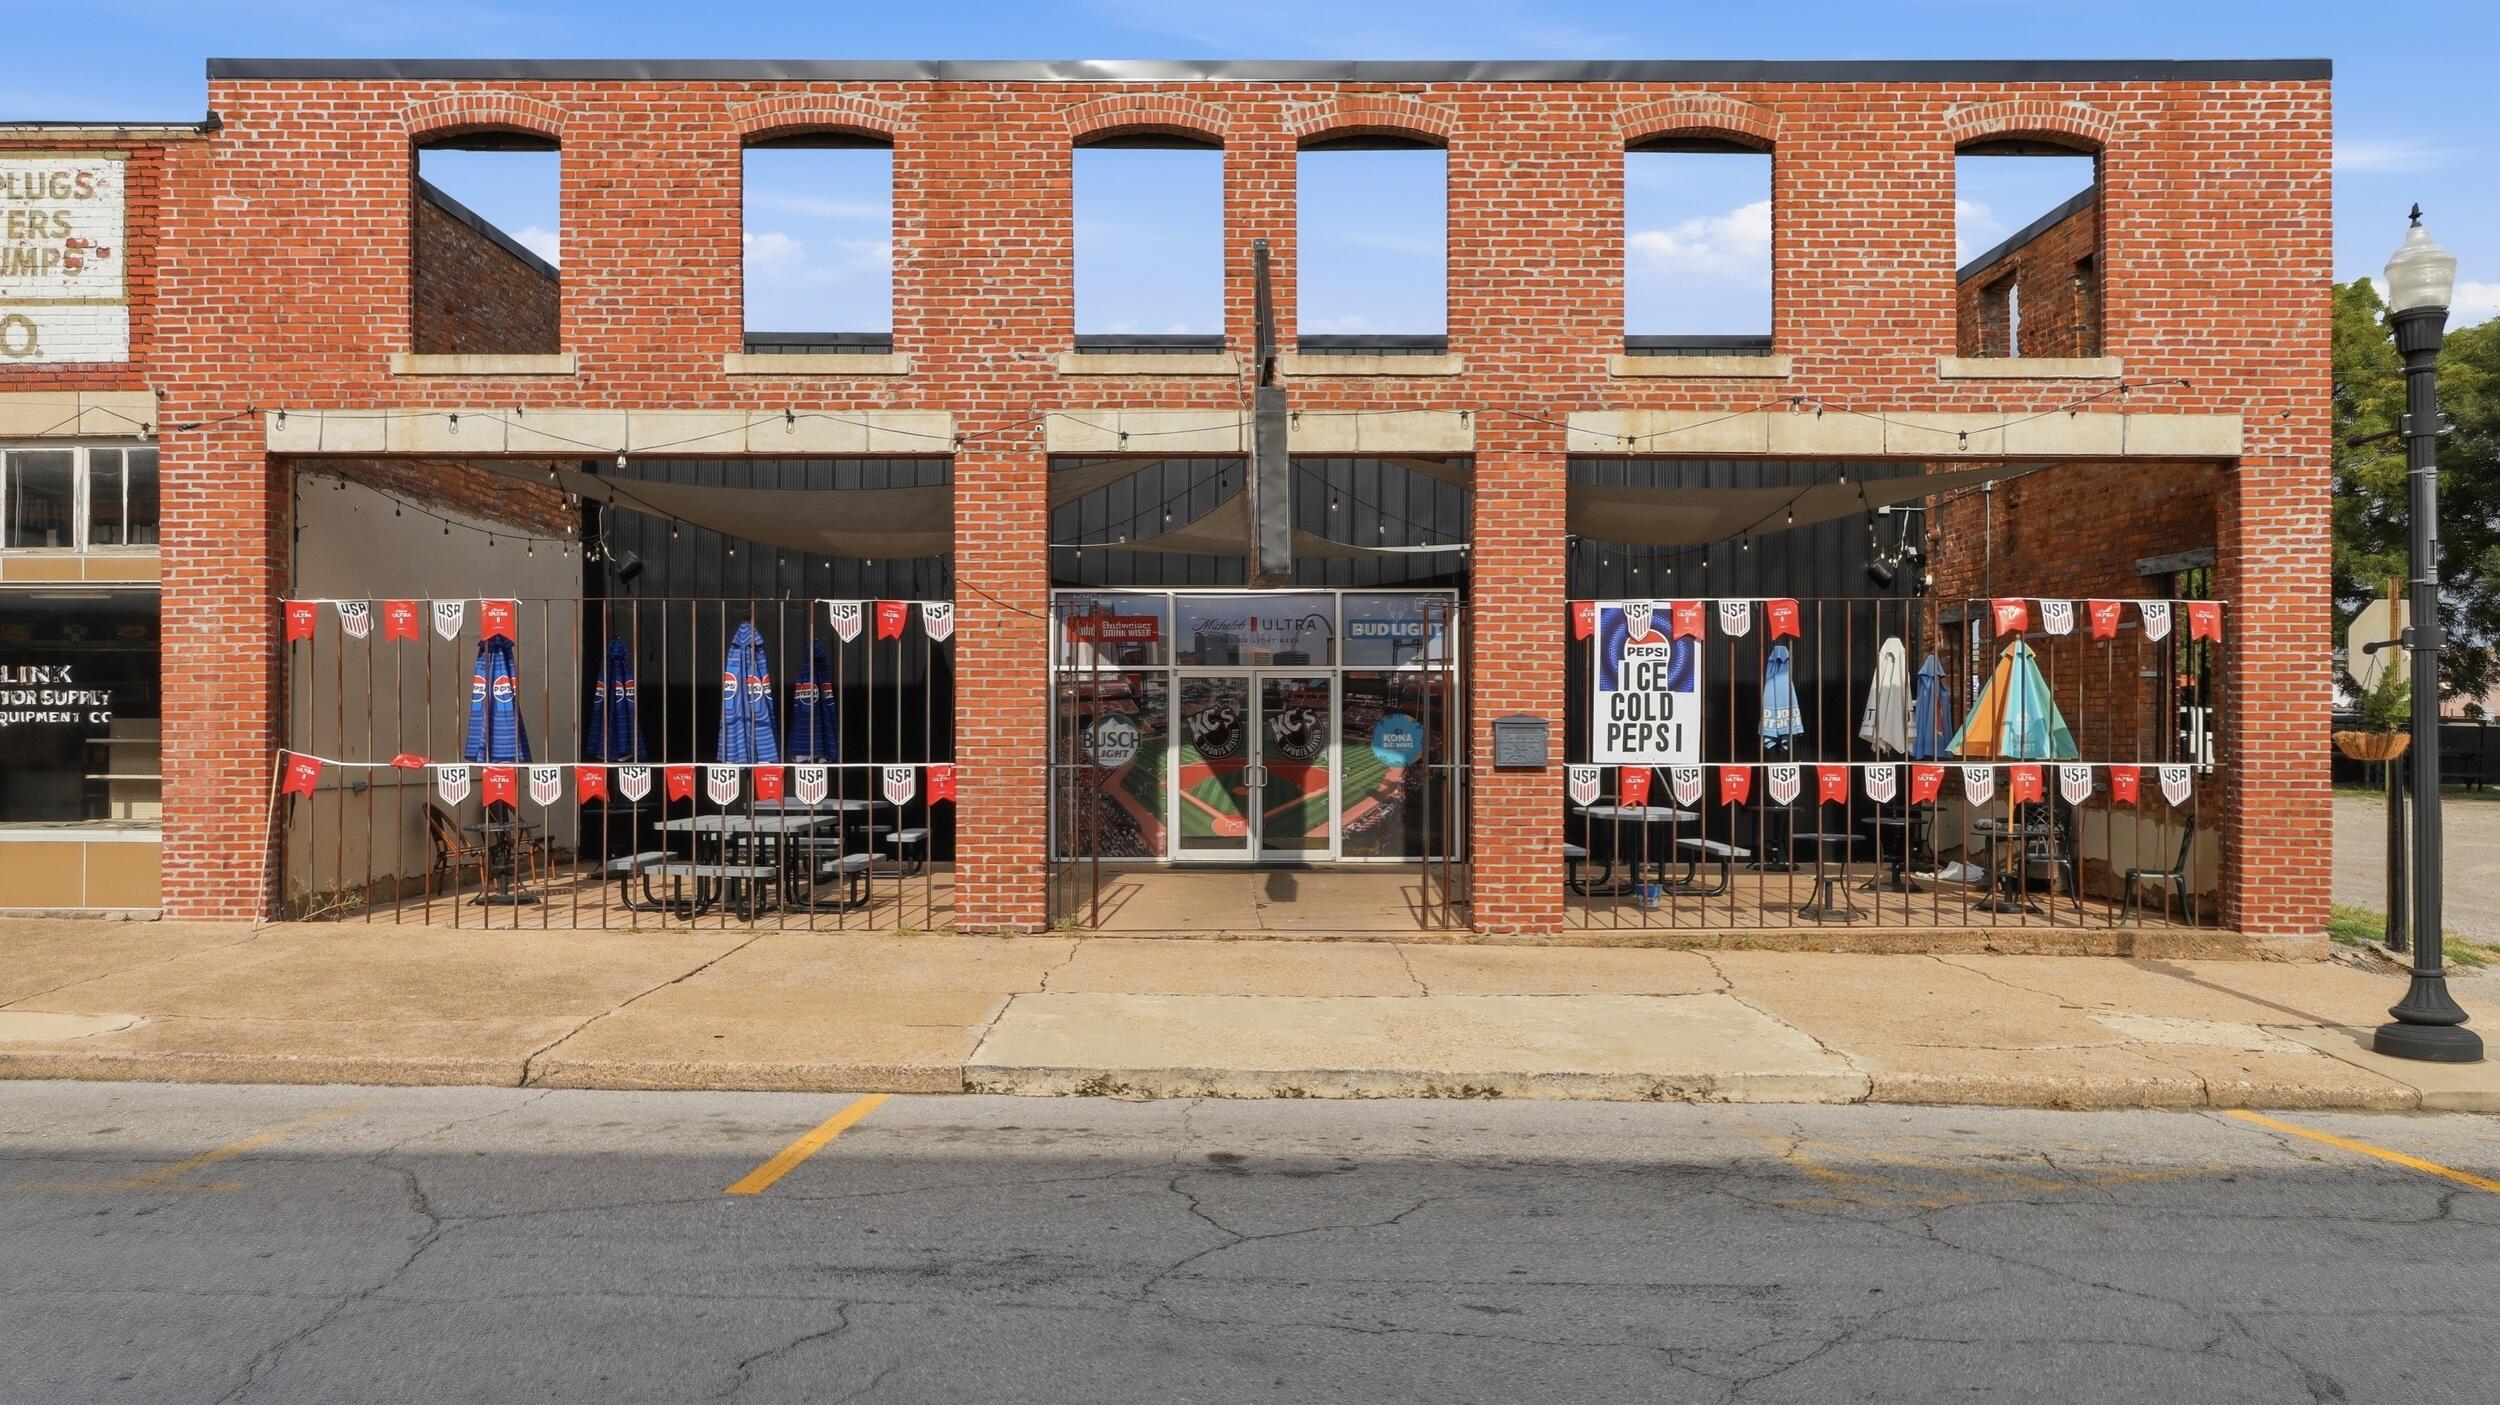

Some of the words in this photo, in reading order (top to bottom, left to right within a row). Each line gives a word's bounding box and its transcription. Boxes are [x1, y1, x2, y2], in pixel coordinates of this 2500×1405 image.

[0, 210, 72, 239] ERS
[341, 603, 367, 616] USA
[438, 604, 461, 618] USA
[833, 605, 857, 619] USA
[926, 605, 949, 619] USA
[1625, 604, 1649, 618] USA
[1722, 603, 1746, 617] USA
[2044, 603, 2068, 617] USA
[1262, 619, 1317, 631] ULTRA
[1352, 623, 1390, 636] BUD
[1627, 647, 1668, 657] PEPSI
[1624, 662, 1667, 692] ICE
[40, 689, 112, 705] SUPPLY
[1611, 692, 1674, 721] COLD
[1383, 733, 1413, 742] KONA
[1607, 723, 1682, 752] PEPSI
[442, 768, 466, 783] USA
[533, 769, 557, 783] USA
[712, 768, 736, 783] USA
[799, 769, 823, 783] USA
[887, 768, 911, 783] USA
[1573, 769, 1597, 783] USA
[1675, 769, 1698, 783] USA
[1772, 767, 1796, 782] USA
[1869, 767, 1893, 782] USA
[1966, 768, 1989, 783] USA
[2063, 767, 2088, 782] USA
[2163, 768, 2187, 783] USA
